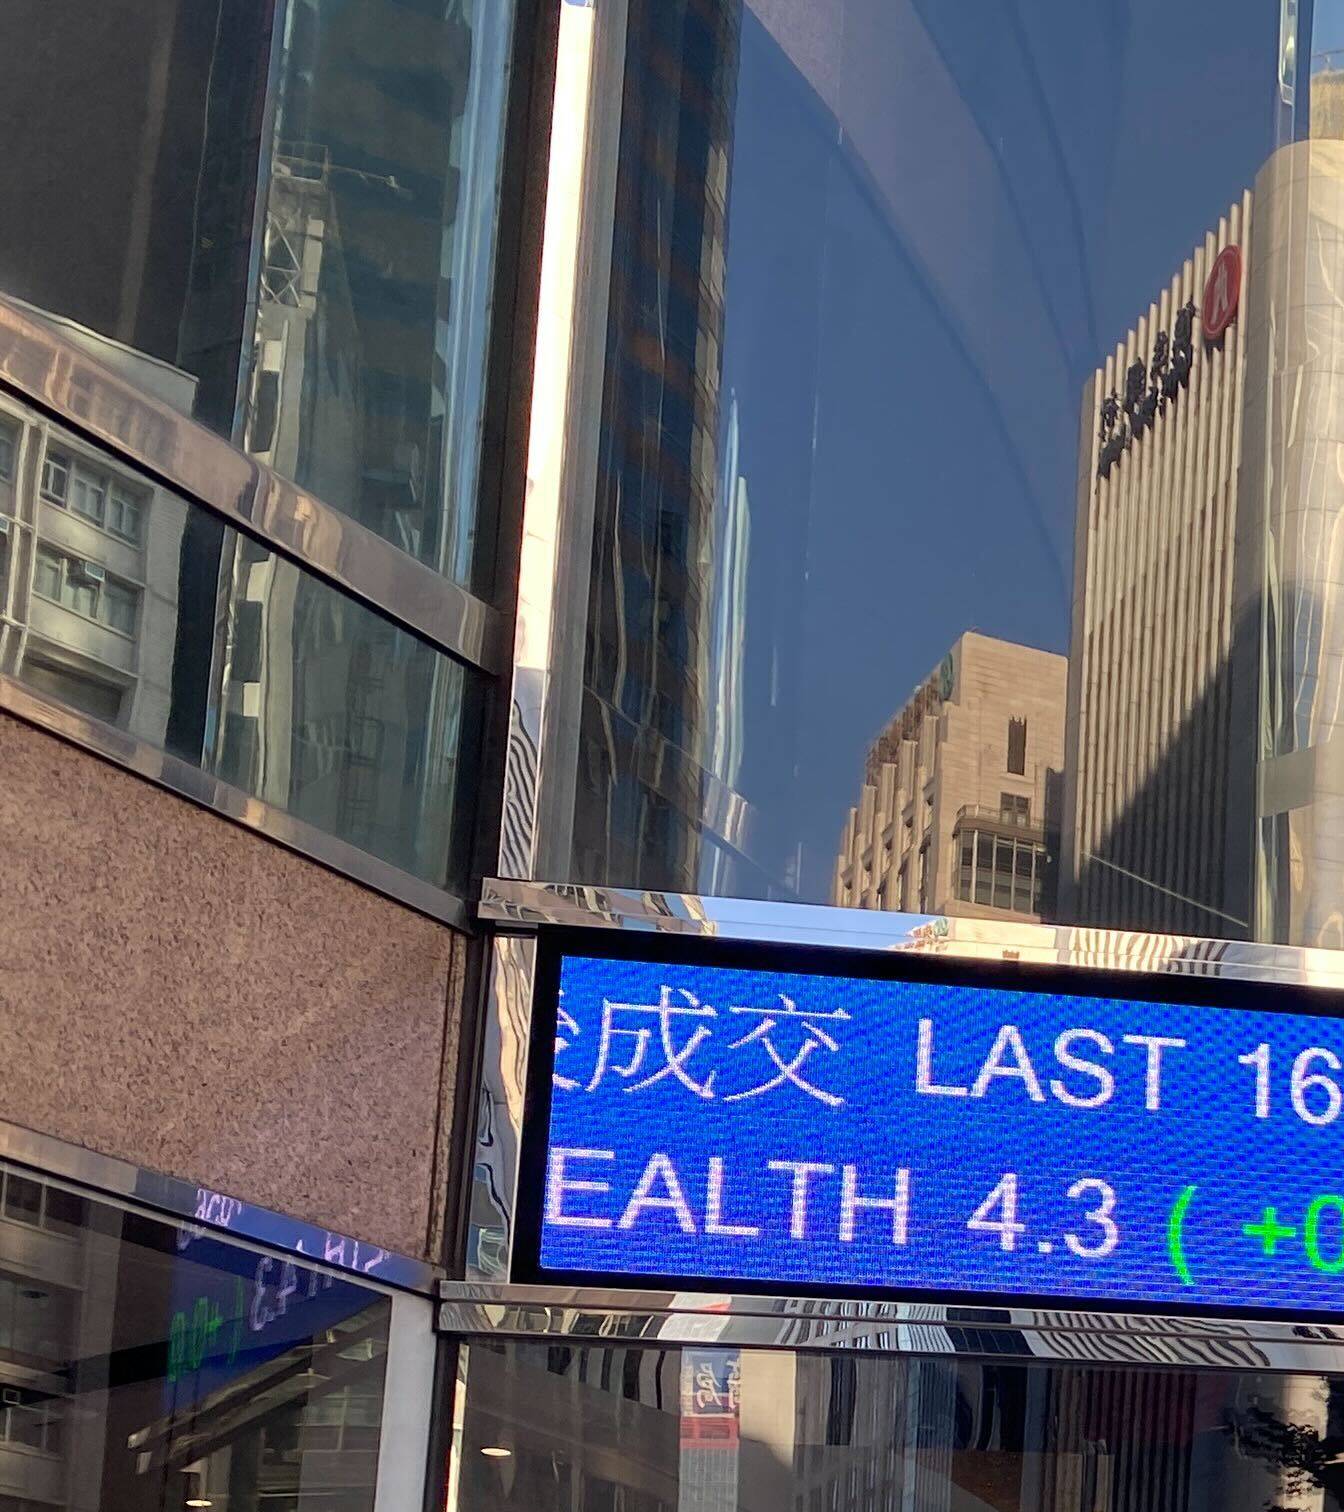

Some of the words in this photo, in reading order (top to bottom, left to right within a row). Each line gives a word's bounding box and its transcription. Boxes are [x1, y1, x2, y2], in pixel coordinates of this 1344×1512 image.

[914, 1018, 1187, 1110] LAST
[545, 1147, 909, 1245] EALTH
[966, 1172, 1121, 1260] 4.3
